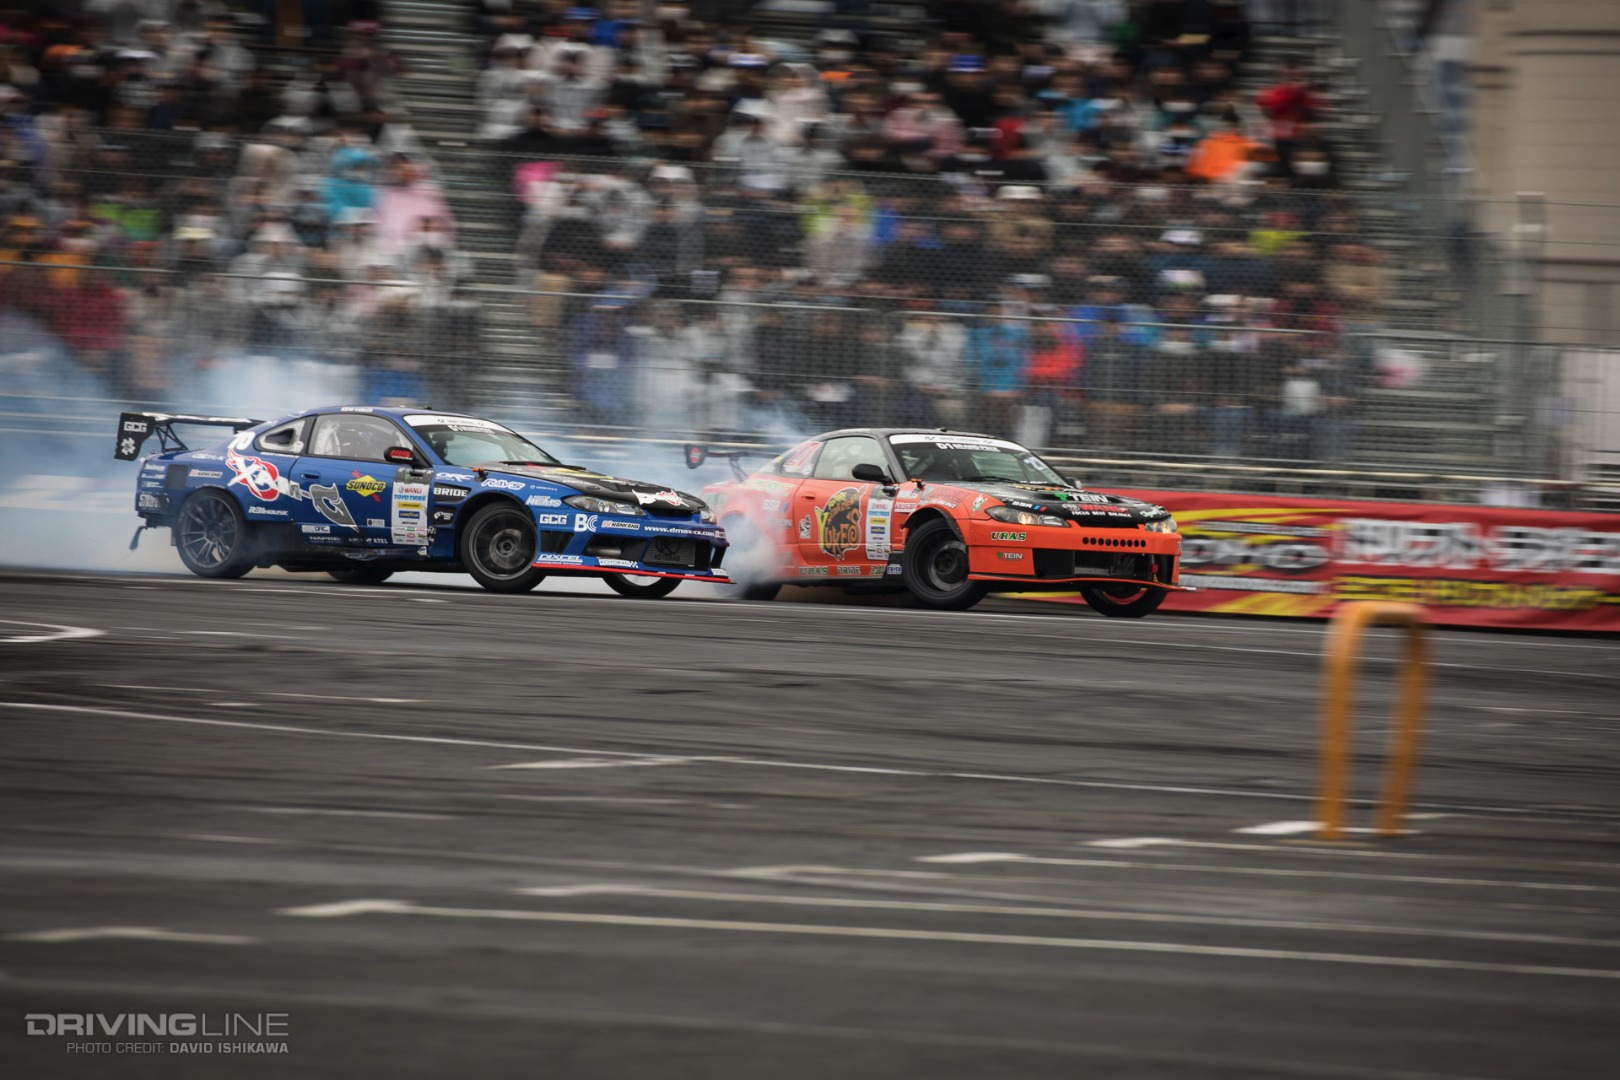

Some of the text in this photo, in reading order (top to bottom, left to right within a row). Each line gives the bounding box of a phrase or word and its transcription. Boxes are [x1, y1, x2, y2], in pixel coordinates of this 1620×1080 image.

[124, 421, 147, 433] GCG
[227, 430, 256, 451] 10
[347, 480, 385, 491] SUNOCO
[481, 478, 526, 490] RAYS
[433, 487, 469, 498] BRIDE
[1068, 493, 1109, 503] TEIN
[539, 514, 567, 525] GCG
[574, 513, 598, 533] BC
[611, 522, 640, 530] NANKANG
[991, 532, 1026, 541] URAS
